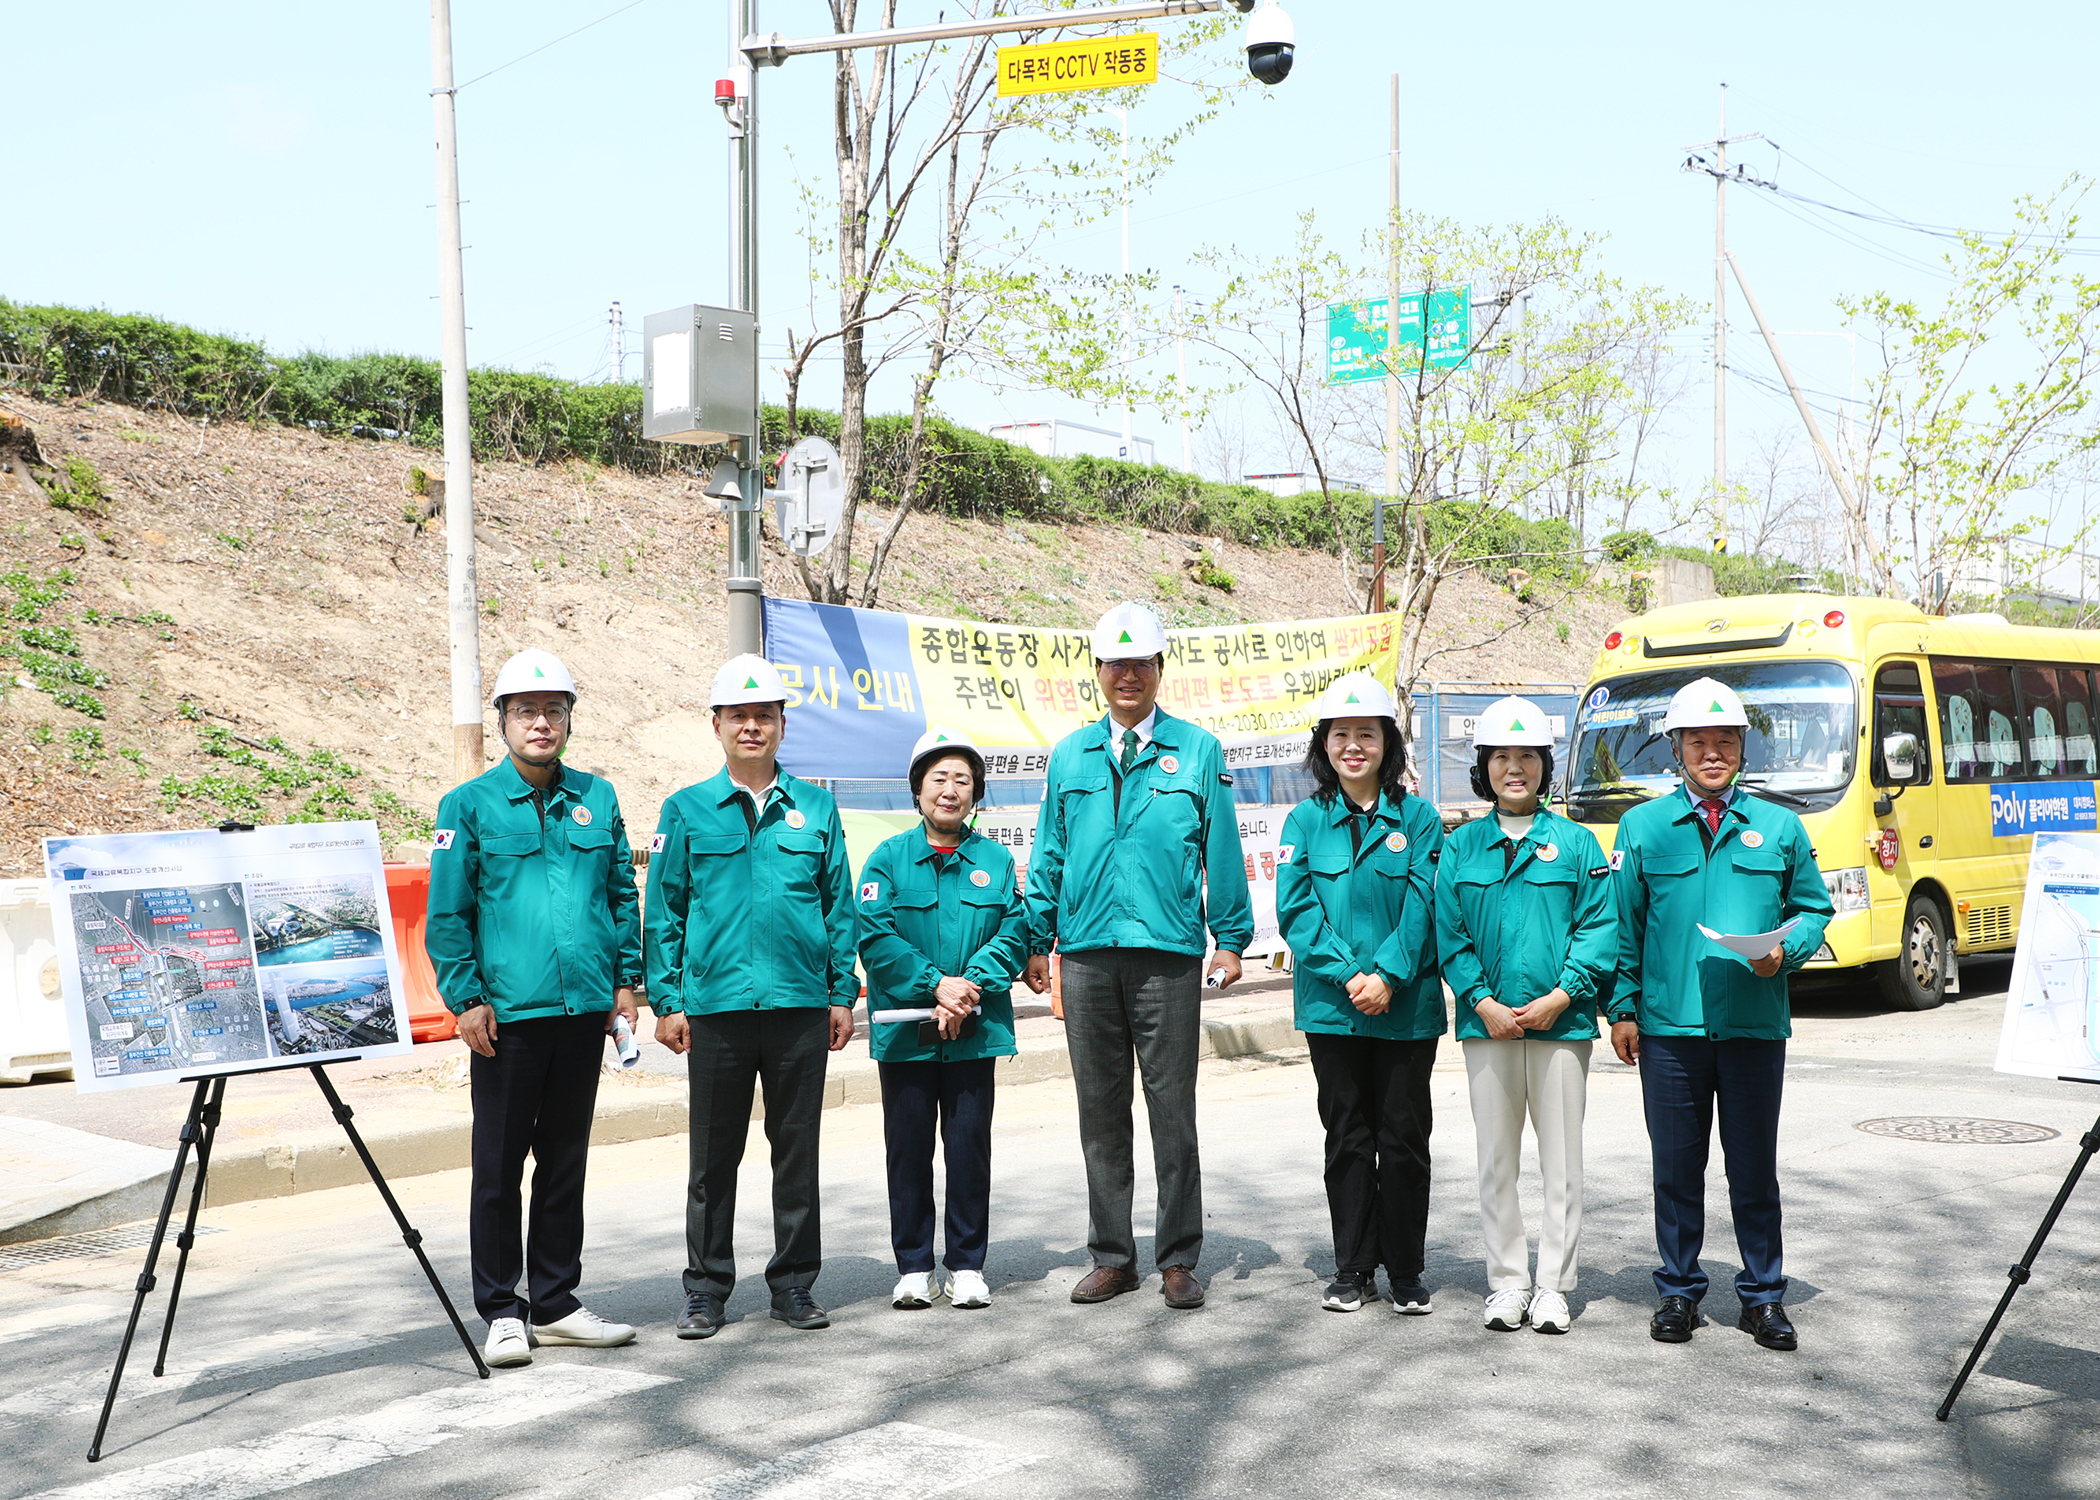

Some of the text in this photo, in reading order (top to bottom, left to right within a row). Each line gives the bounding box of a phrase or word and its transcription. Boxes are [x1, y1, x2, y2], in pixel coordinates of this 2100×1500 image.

[1008, 48, 1147, 84] 다목적 CCTV 작동중
[921, 622, 1392, 668] 종합운동장 사거 차도 공사로 인하여 쌈지공원
[774, 664, 916, 712] 공사 안내
[954, 676, 1025, 711] 주변이
[1034, 678, 1110, 712] 위험하
[1220, 675, 1278, 703] 보도로
[1592, 707, 1636, 724] 어린이보호
[985, 754, 1019, 774] 불편을
[1991, 790, 2027, 829] Poly
[2029, 797, 2069, 822] 폴리어학원
[1882, 840, 1898, 858] 정지
